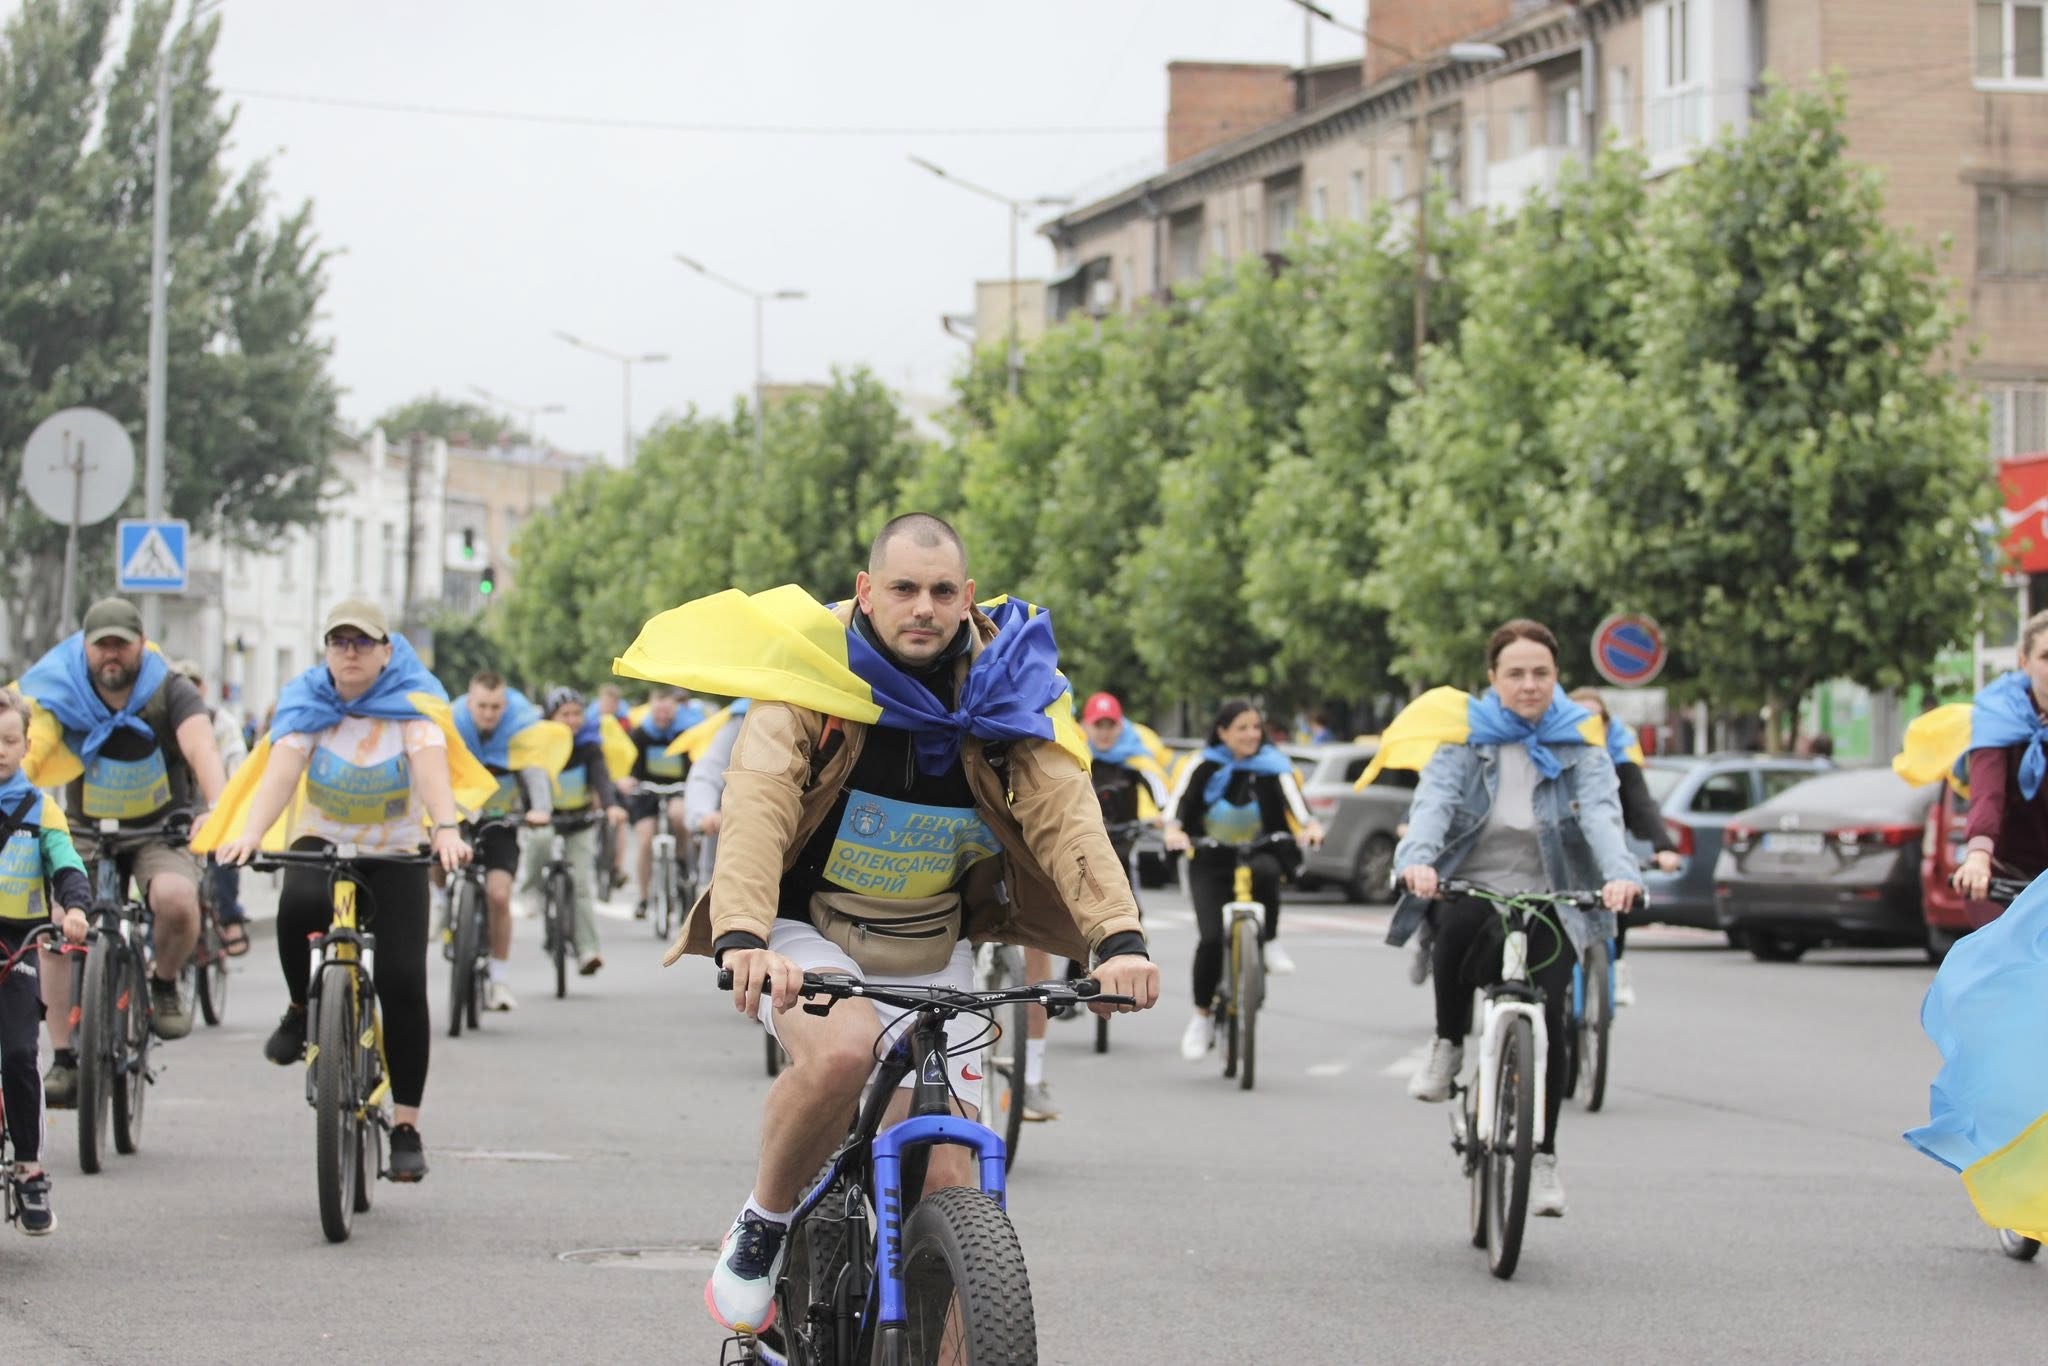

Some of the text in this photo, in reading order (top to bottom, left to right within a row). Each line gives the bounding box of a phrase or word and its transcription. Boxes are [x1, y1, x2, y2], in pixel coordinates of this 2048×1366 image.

[882, 830, 979, 851] УКРА
[838, 847, 954, 874] ОЛЕКСАНД
[830, 861, 908, 893] ЦЕБРІЙ
[884, 1187, 902, 1280] TITAN
